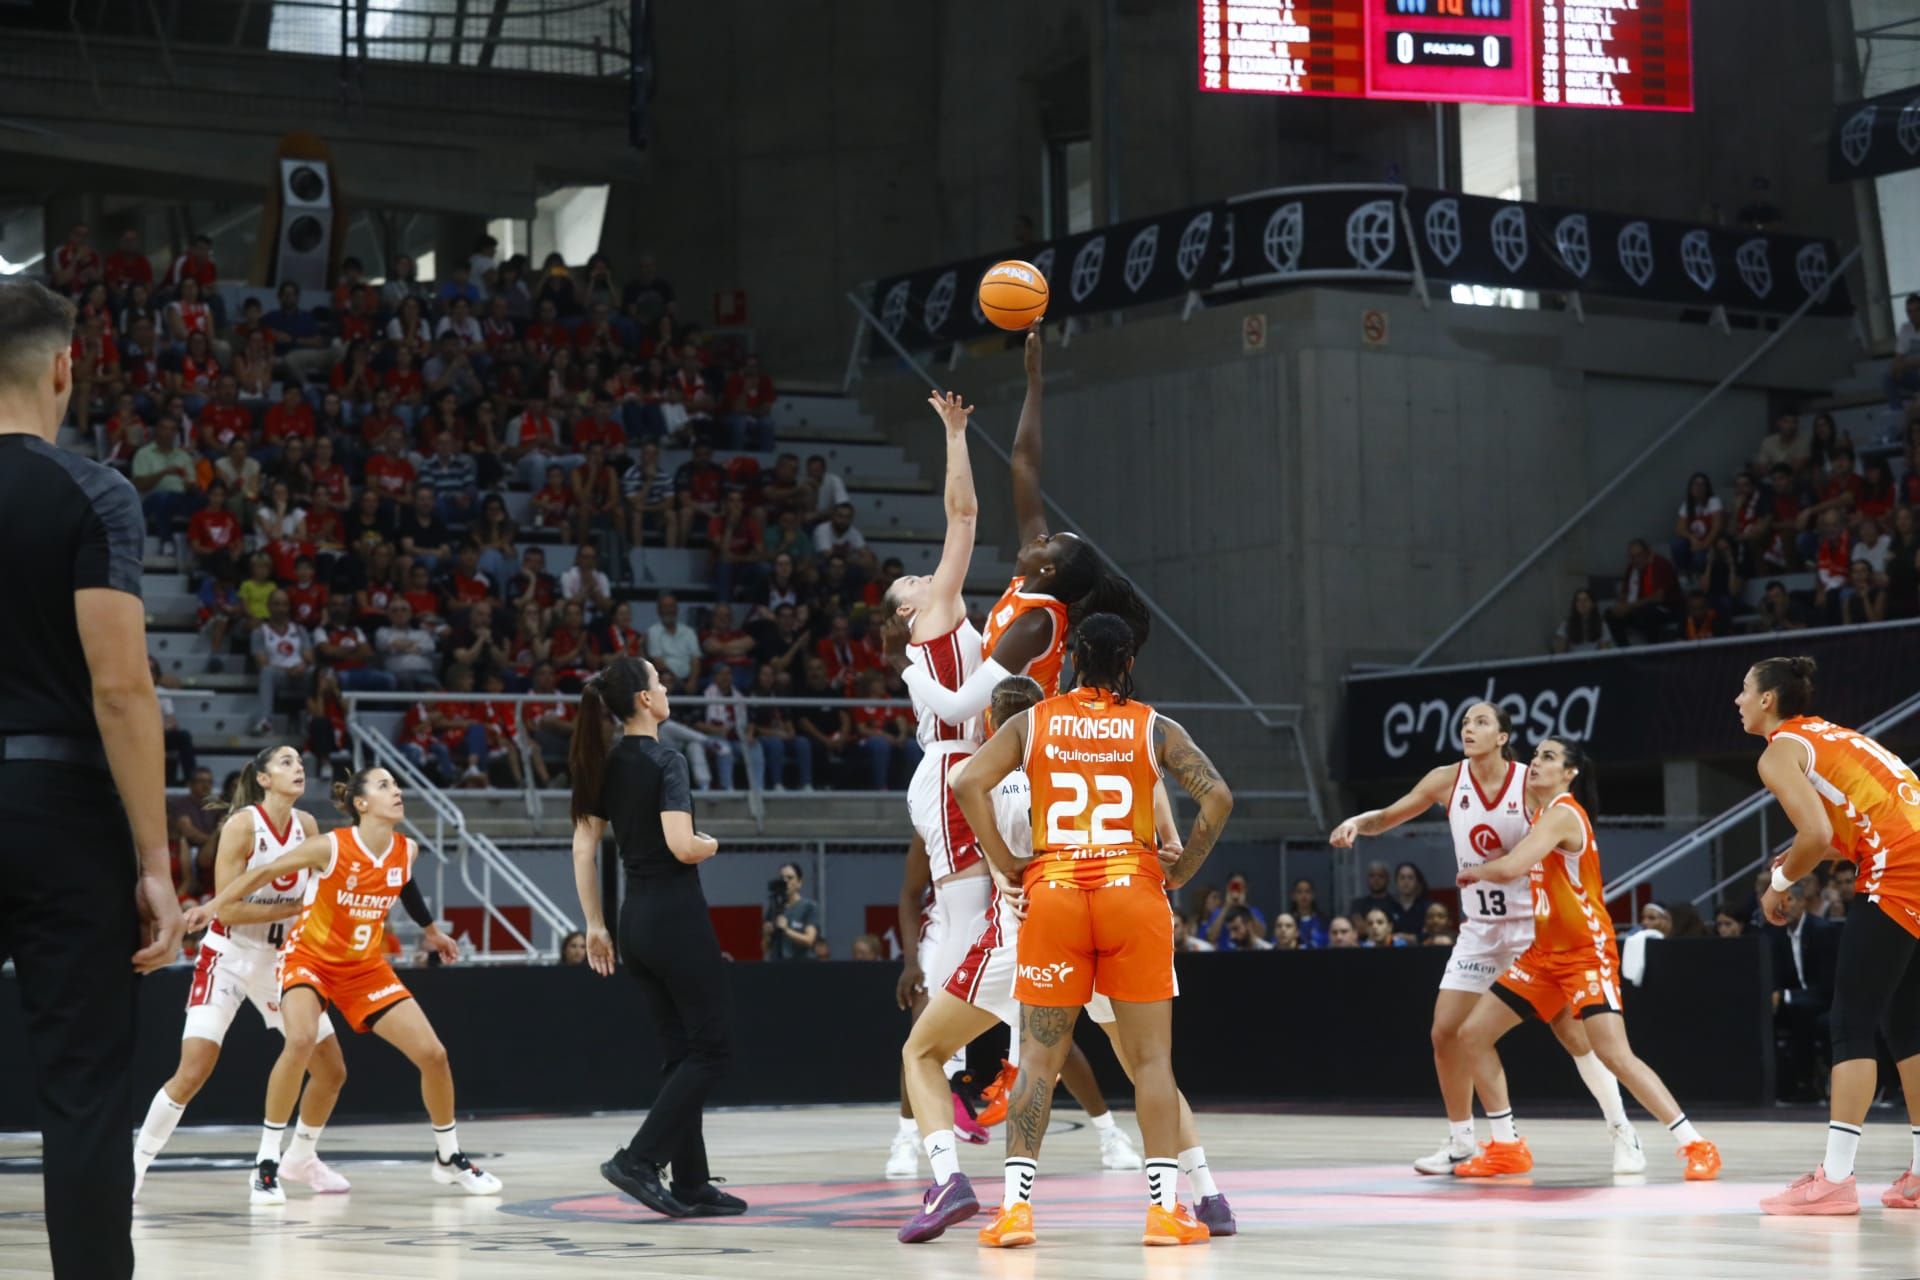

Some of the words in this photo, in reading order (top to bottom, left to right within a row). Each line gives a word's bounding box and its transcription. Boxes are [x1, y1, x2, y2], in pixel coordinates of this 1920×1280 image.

[1397, 32, 1414, 64] 0
[1483, 35, 1500, 67] 0
[1049, 715, 1134, 740] ATKINSON
[1384, 677, 1600, 758] endesa
[1002, 784, 1020, 795] AIR
[1047, 772, 1134, 846] 22
[349, 907, 383, 920] BASKET
[1476, 889, 1507, 916] 13
[267, 923, 284, 950] 4
[353, 924, 372, 951] 9
[1018, 963, 1053, 982] MGS
